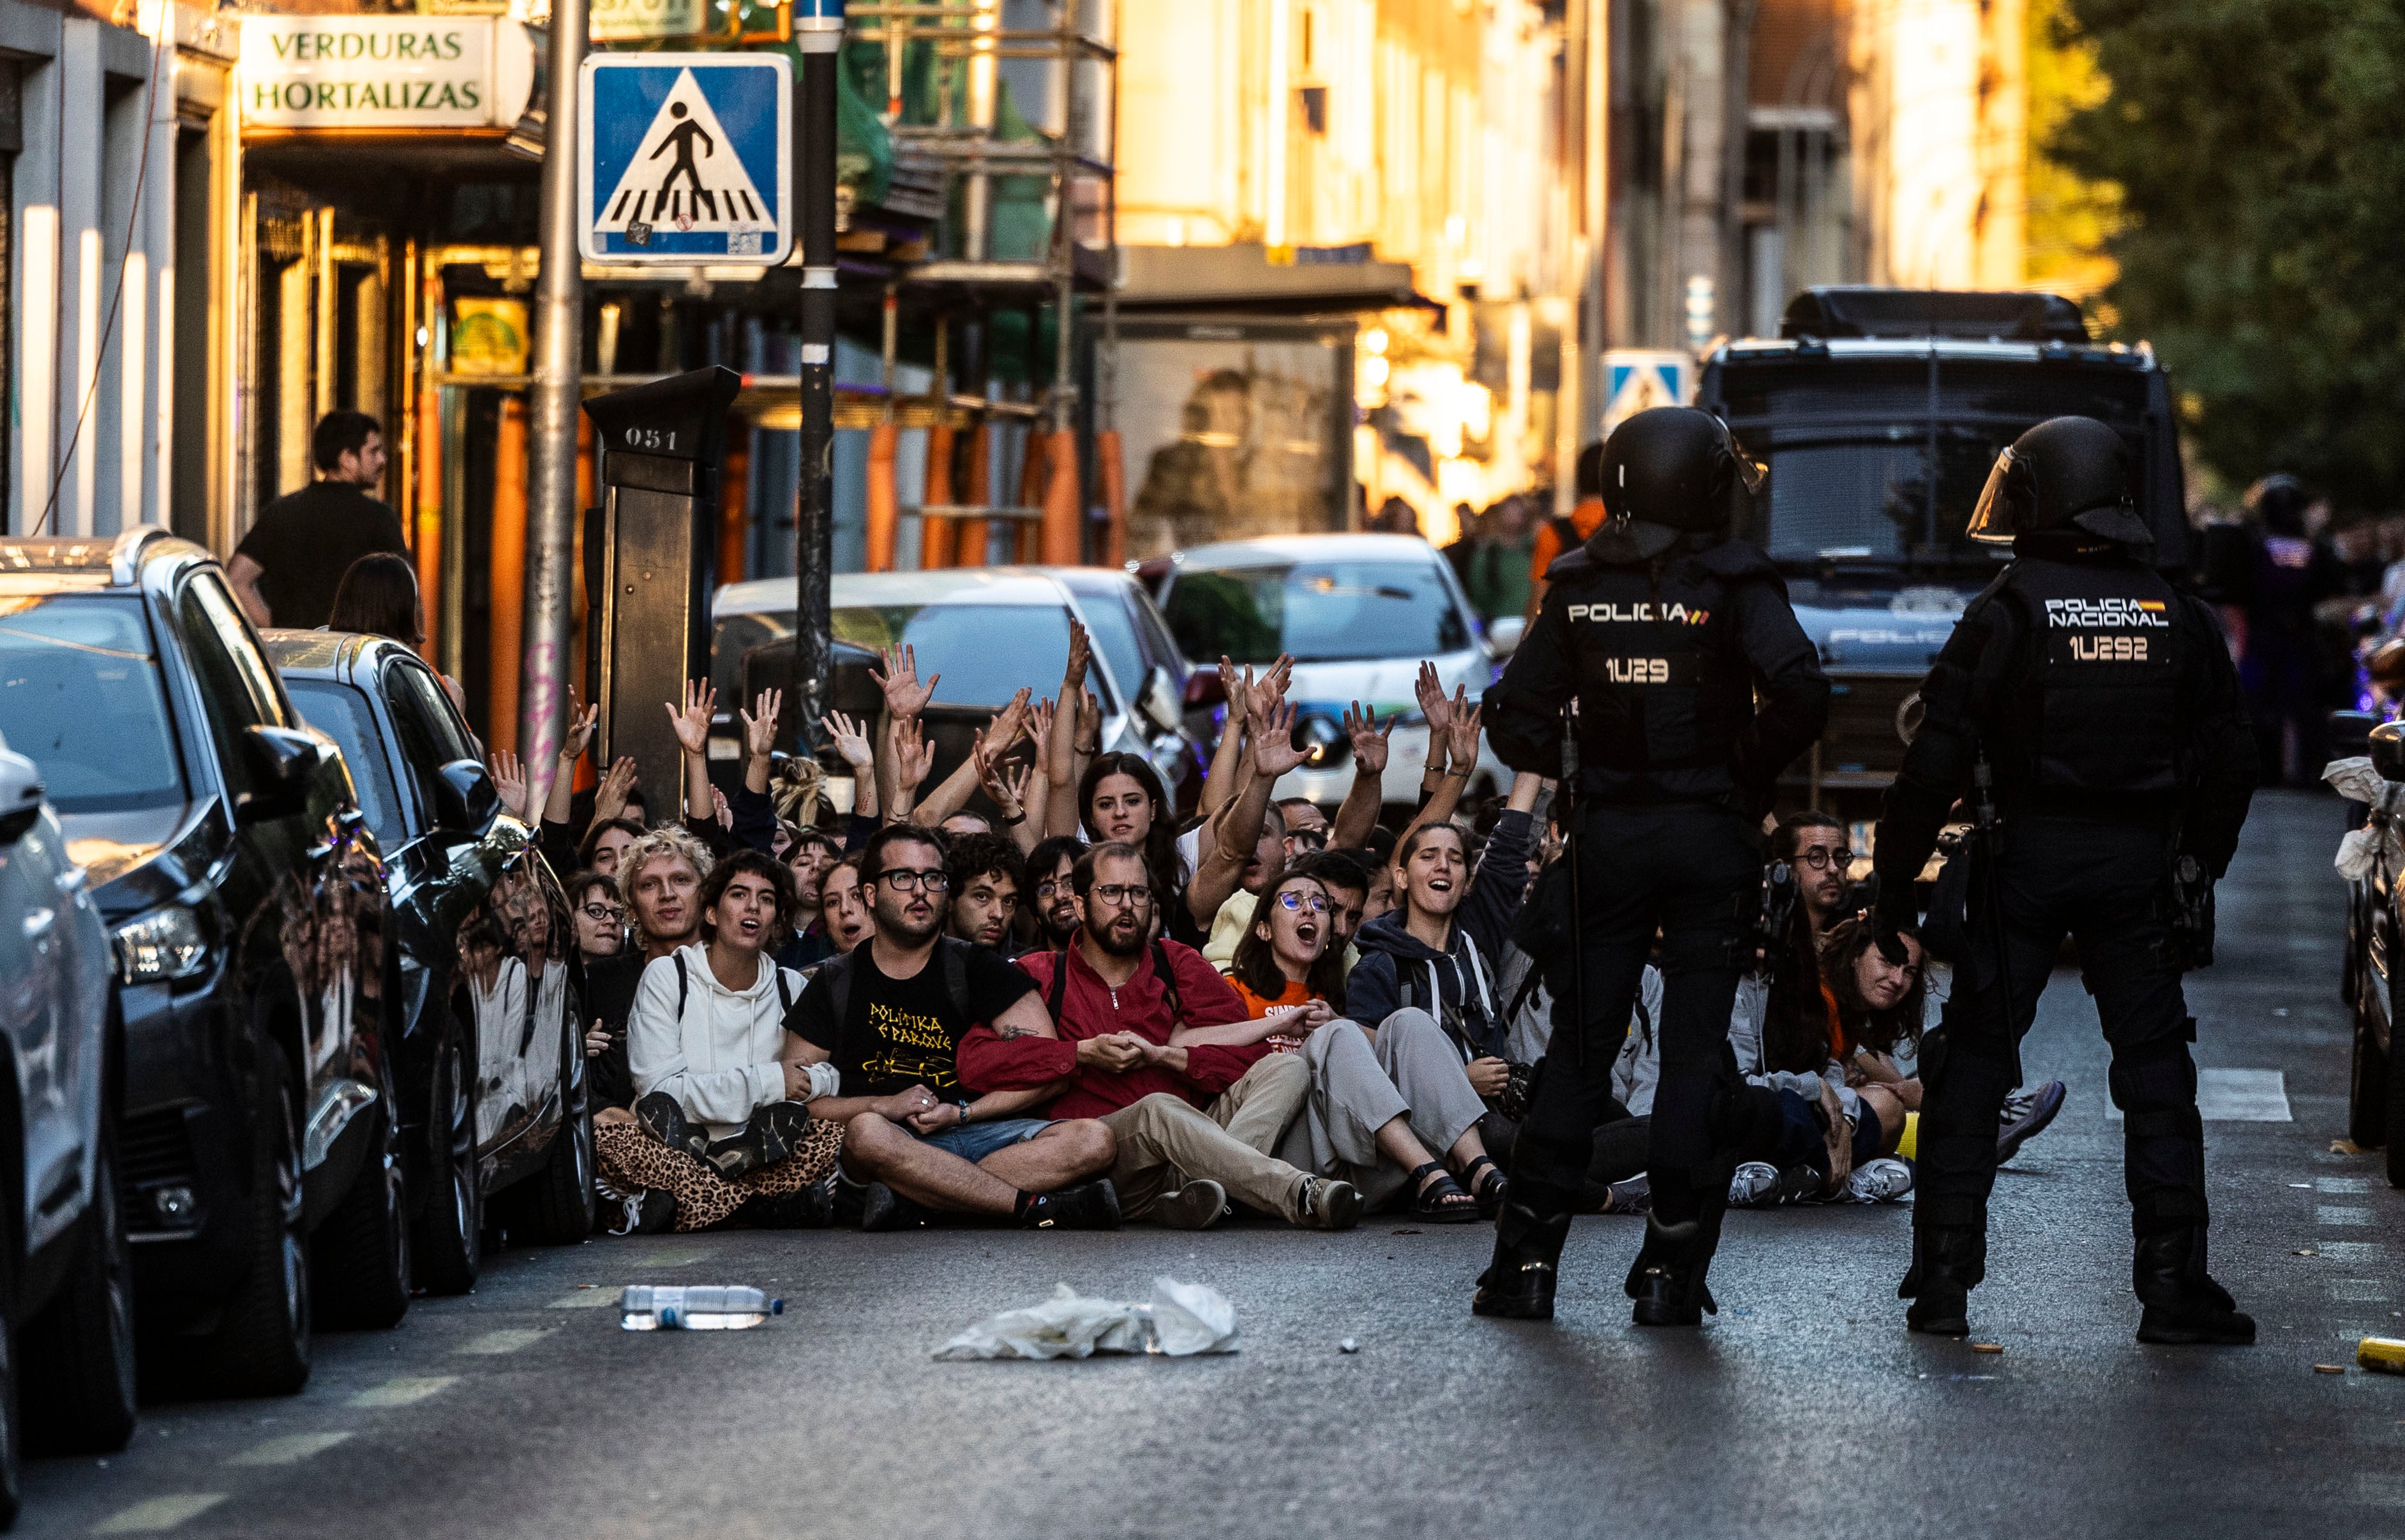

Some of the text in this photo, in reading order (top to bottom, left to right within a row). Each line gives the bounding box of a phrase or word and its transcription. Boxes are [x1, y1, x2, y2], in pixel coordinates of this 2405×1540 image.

[271, 32, 461, 61] VERDURAS
[254, 80, 480, 110] HORTALIZAS
[626, 428, 675, 450] 051
[1568, 603, 1688, 622] POLICIA
[2045, 598, 2143, 612] POLICIA
[2049, 613, 2169, 627] NACIONAL
[2069, 636, 2147, 661] 1U292
[1606, 658, 1669, 683] 1U29
